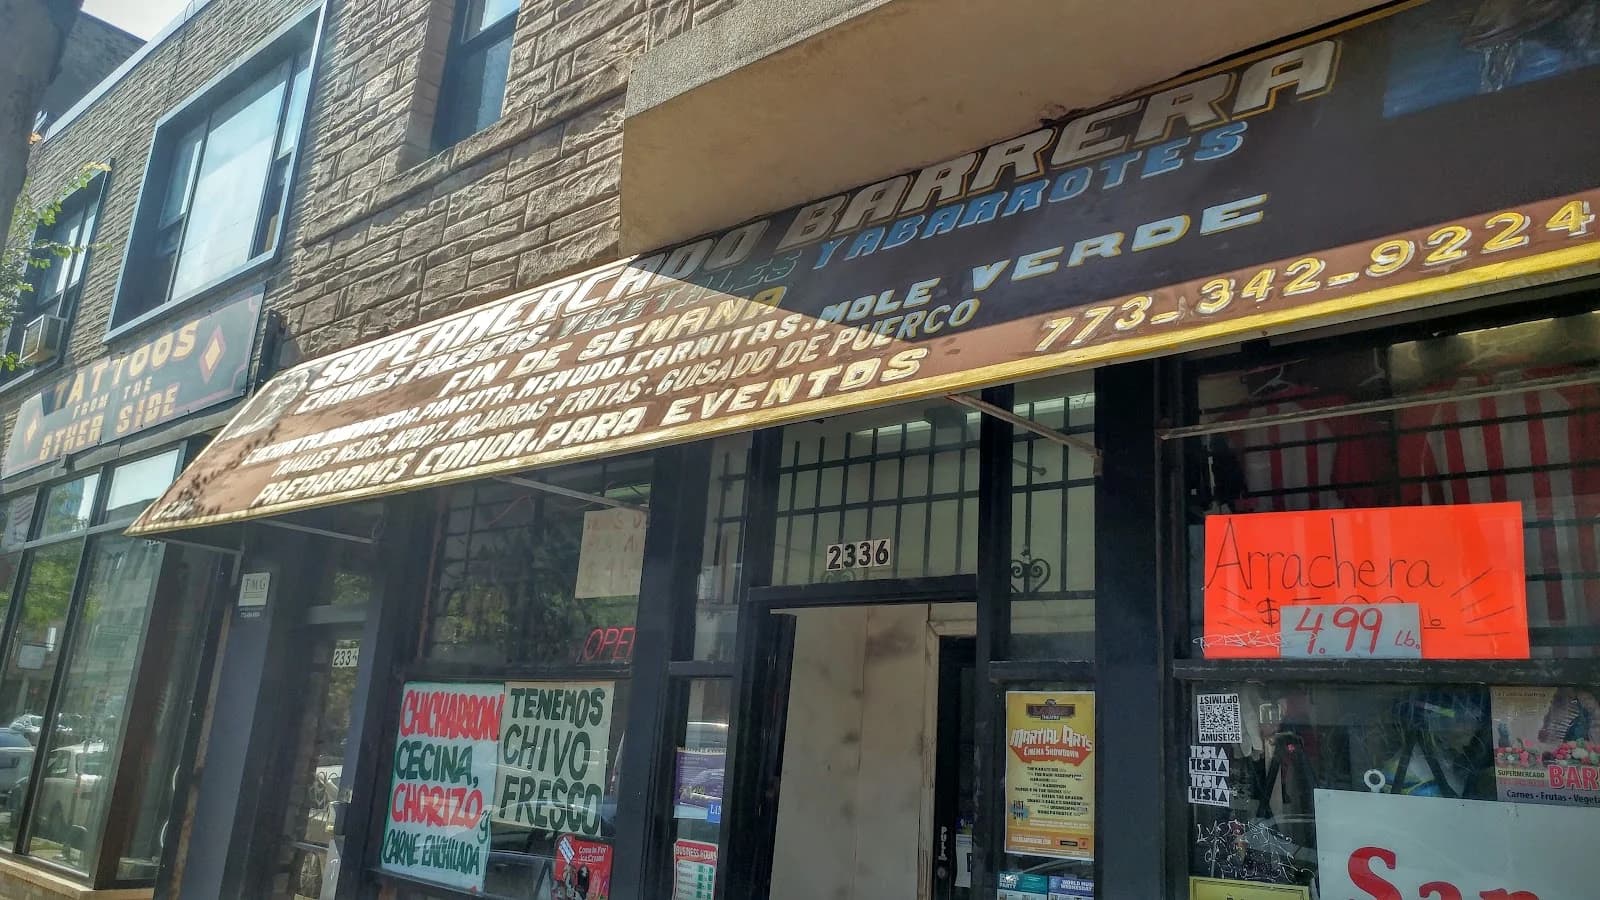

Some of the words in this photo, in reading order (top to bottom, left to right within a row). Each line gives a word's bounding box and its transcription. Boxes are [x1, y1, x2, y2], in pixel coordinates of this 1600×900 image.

[305, 218, 771, 394] SUPERMERCADO
[775, 40, 1341, 251] BARRERA
[813, 278, 942, 330] MOLE
[972, 193, 1268, 291] VERDE
[54, 320, 200, 410] TATTOOS
[437, 359, 509, 398] FIN
[507, 342, 574, 379] DE
[577, 286, 787, 361] SEMANA
[655, 347, 777, 395] GUISADO
[777, 333, 830, 368] DE
[828, 298, 981, 357] PUERCO
[40, 415, 105, 461] OTHER
[115, 382, 181, 433] SIDE
[72, 393, 110, 420] FROM
[123, 376, 153, 399] THE
[250, 450, 418, 508] PREPARAMOS
[535, 406, 648, 452] PARA
[660, 347, 928, 427] EVENTOS
[827, 540, 890, 570] 2336
[1206, 518, 1444, 590] Arrachera
[583, 627, 637, 661] OPE
[1294, 606, 1384, 655] 4.99
[401, 690, 506, 742] CHICHARRON
[510, 687, 605, 729] TENEMOS
[1200, 695, 1238, 704] OPTIMIST
[395, 740, 479, 788] CECINA,
[502, 723, 592, 782] CHIVO
[1190, 746, 1228, 759] TESLA
[1190, 759, 1227, 772] TESLA
[1190, 788, 1228, 802] TESLA
[1191, 775, 1228, 789] TESLA
[1506, 789, 1534, 799] Carnes
[1541, 790, 1567, 801] Frutas
[1547, 764, 1600, 790] BAR
[391, 783, 483, 829] CHORIZO
[500, 775, 603, 836] FRESCO
[383, 829, 421, 867] CARNE
[421, 834, 480, 876] ENCHILADA
